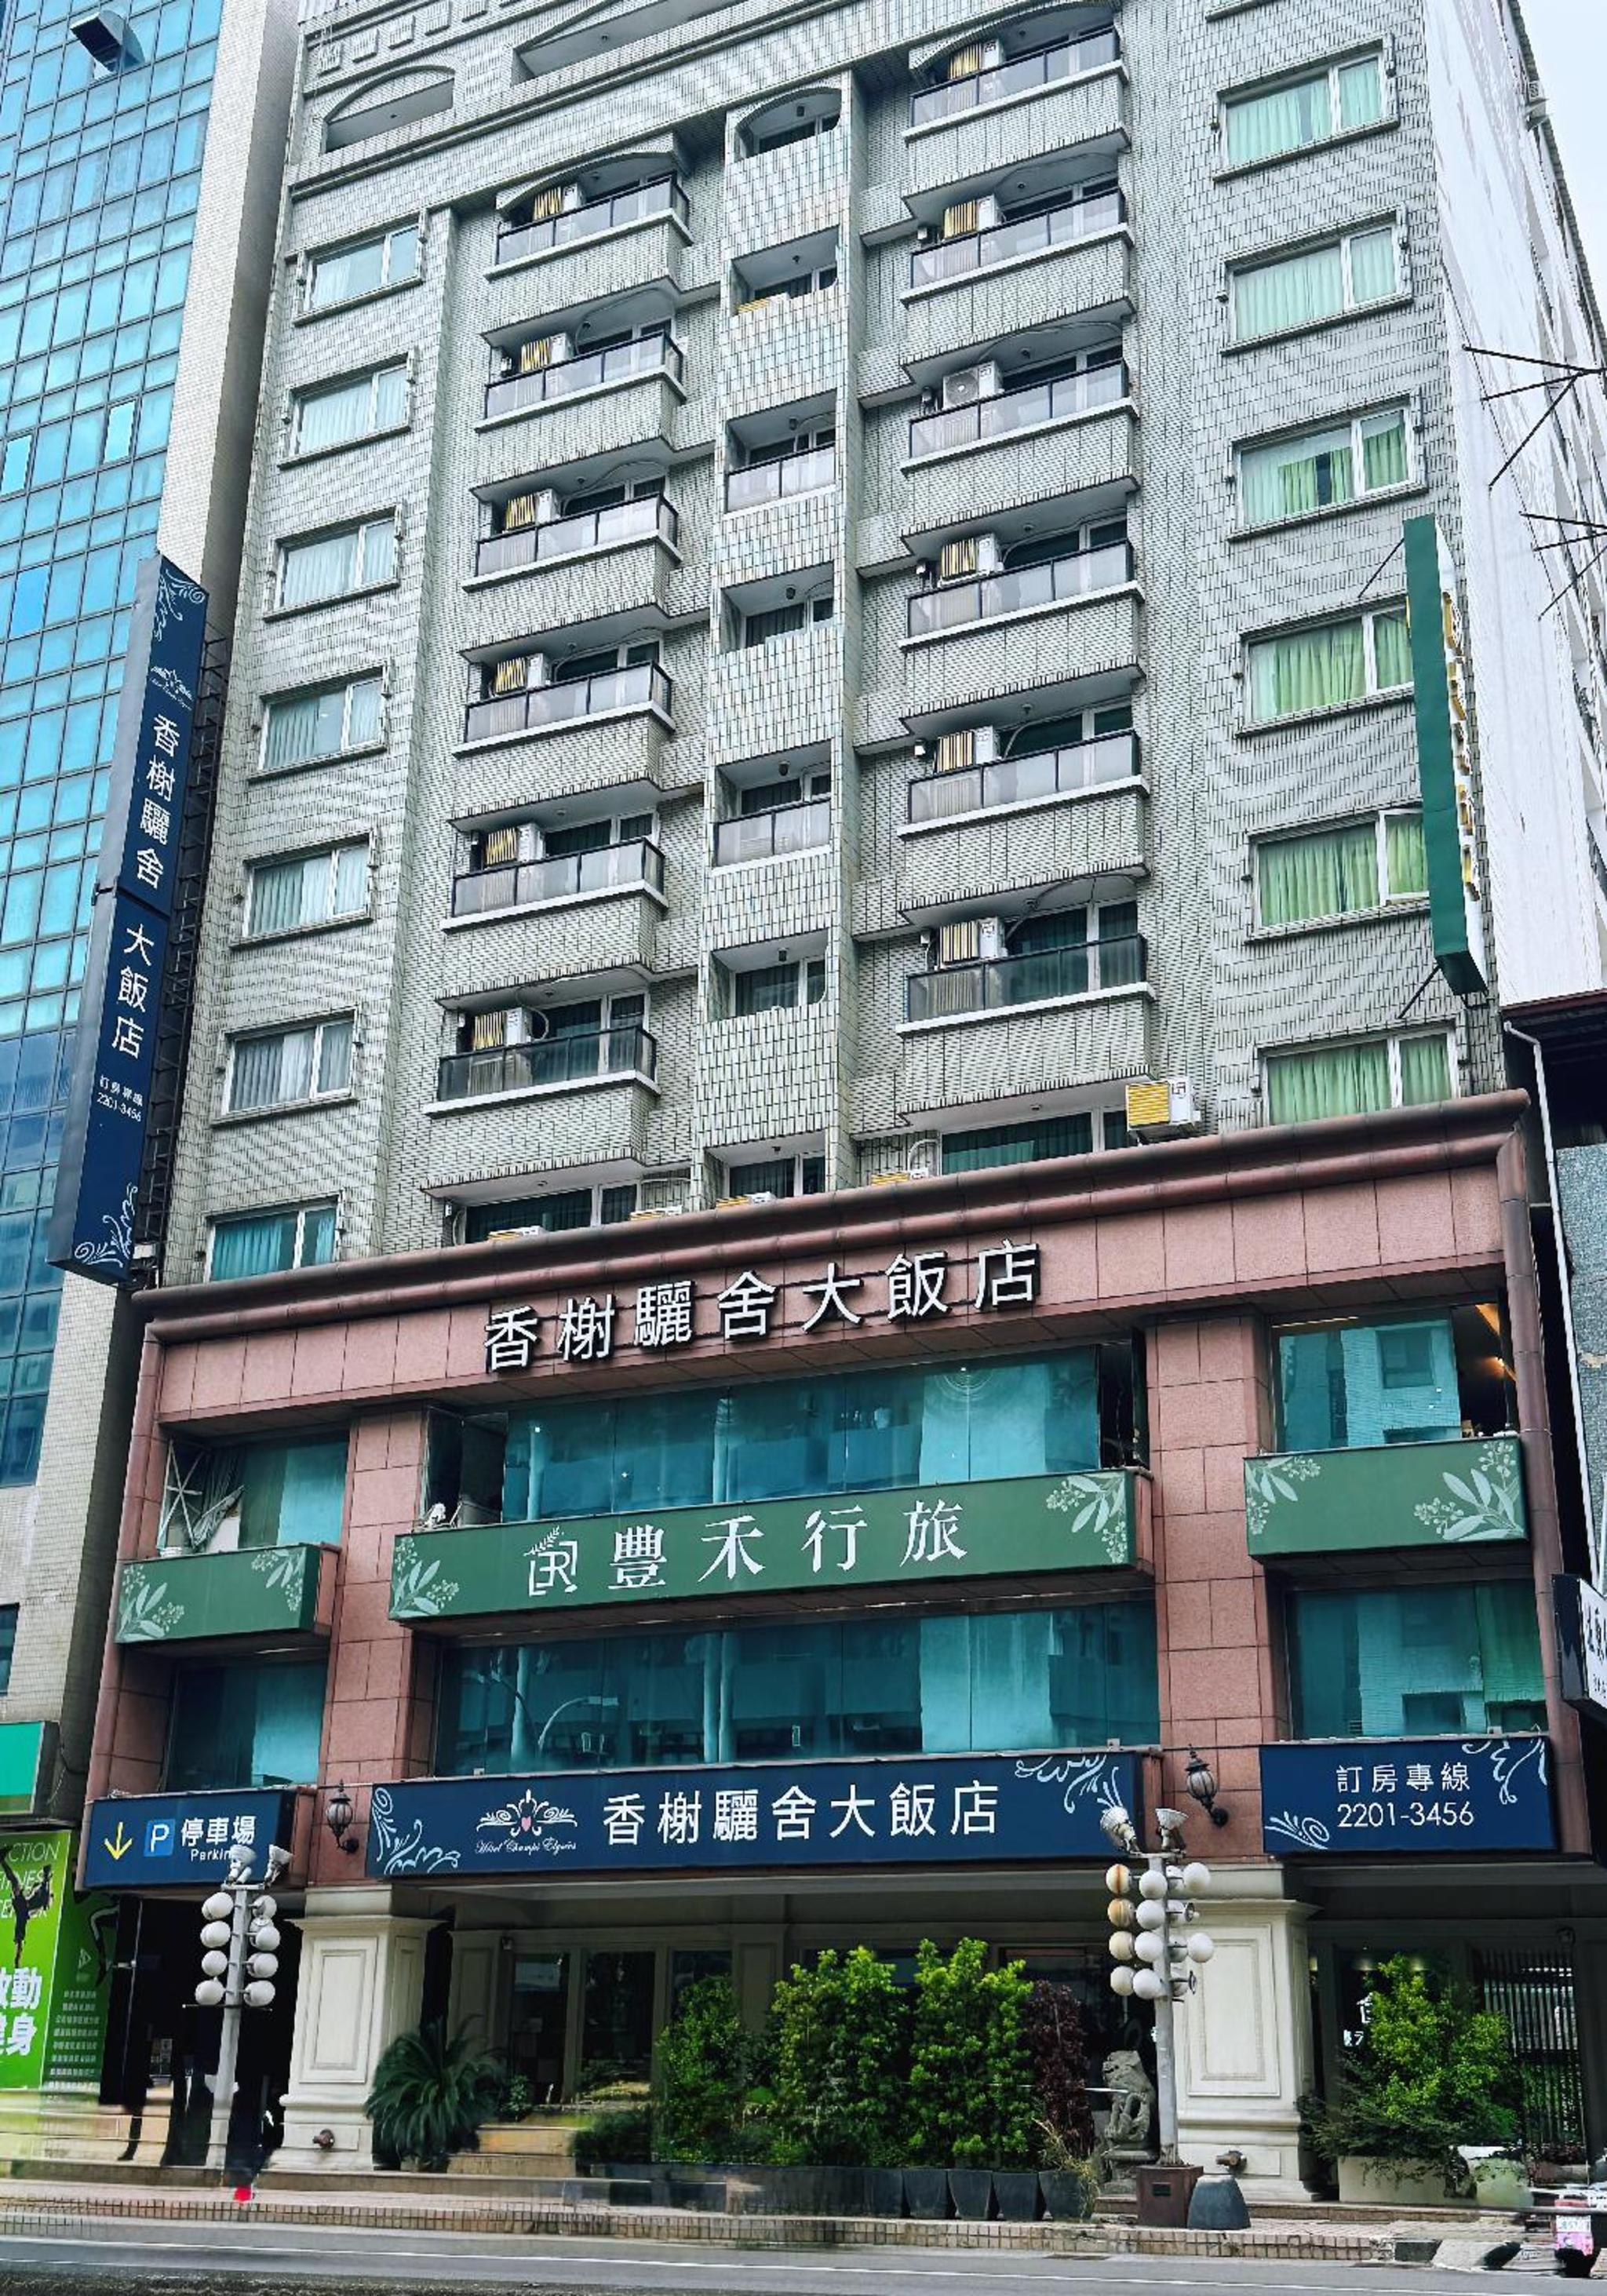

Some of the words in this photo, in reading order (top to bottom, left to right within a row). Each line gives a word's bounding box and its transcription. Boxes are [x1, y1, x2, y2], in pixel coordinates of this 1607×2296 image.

[484, 1239, 1039, 1372] 香榭驪舍大飯店
[608, 1499, 967, 1589] 豐禾行旅
[1336, 1762, 1470, 1793] 訂房專線
[603, 1780, 999, 1845] 香榭驪舍大飯店
[1337, 1801, 1474, 1828] 2201-3456
[180, 1815, 256, 1846] 停車場
[2, 1841, 60, 1863] CTION
[191, 1848, 231, 1861] Parkin
[0, 2012, 37, 2056] 身
